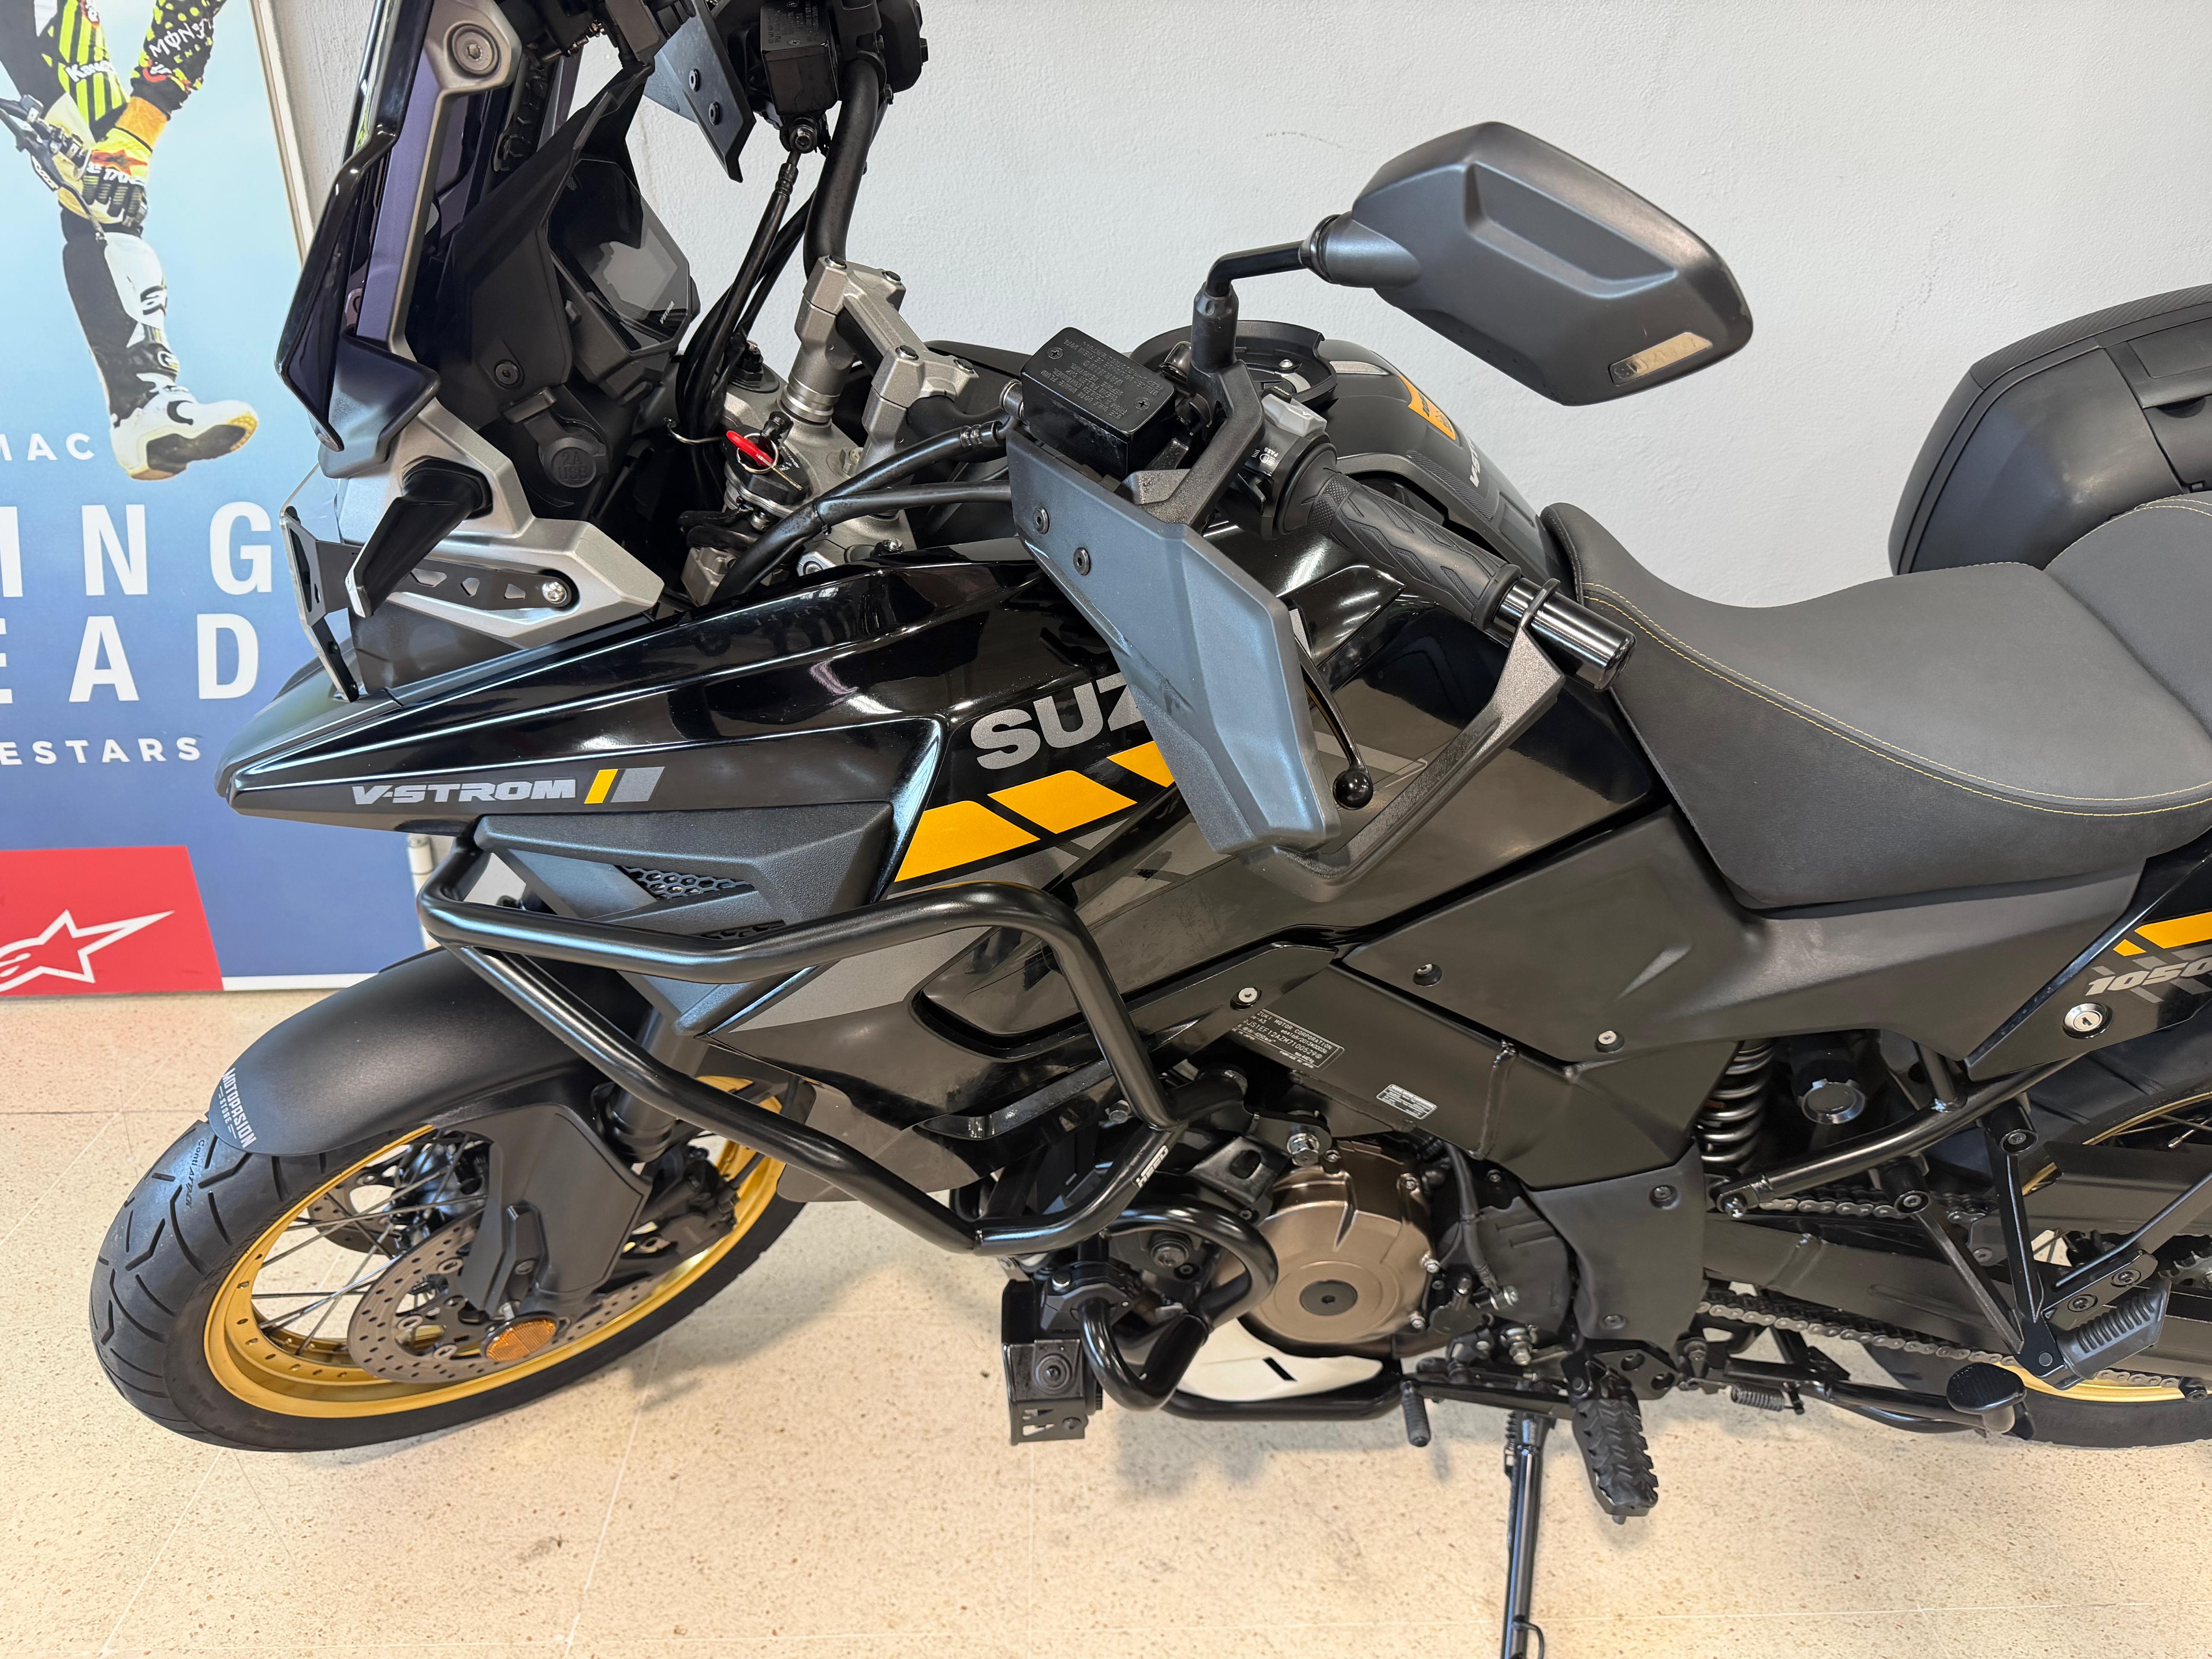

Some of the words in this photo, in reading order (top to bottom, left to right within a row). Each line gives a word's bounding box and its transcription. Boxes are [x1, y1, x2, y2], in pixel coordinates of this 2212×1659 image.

[1041, 370, 1058, 382] FLUID
[1264, 447, 1279, 458] PASS
[0, 613, 259, 704] AD
[0, 737, 200, 765] ESTARS
[352, 779, 575, 804] V-STROM
[2085, 957, 2212, 995] 1050
[1273, 1019, 1294, 1030] MOTOR
[1293, 1029, 1333, 1049] CORPORATION
[219, 1097, 232, 1125] STORE
[222, 1067, 257, 1148] MOTOPASION
[192, 1139, 205, 1167] Conti
